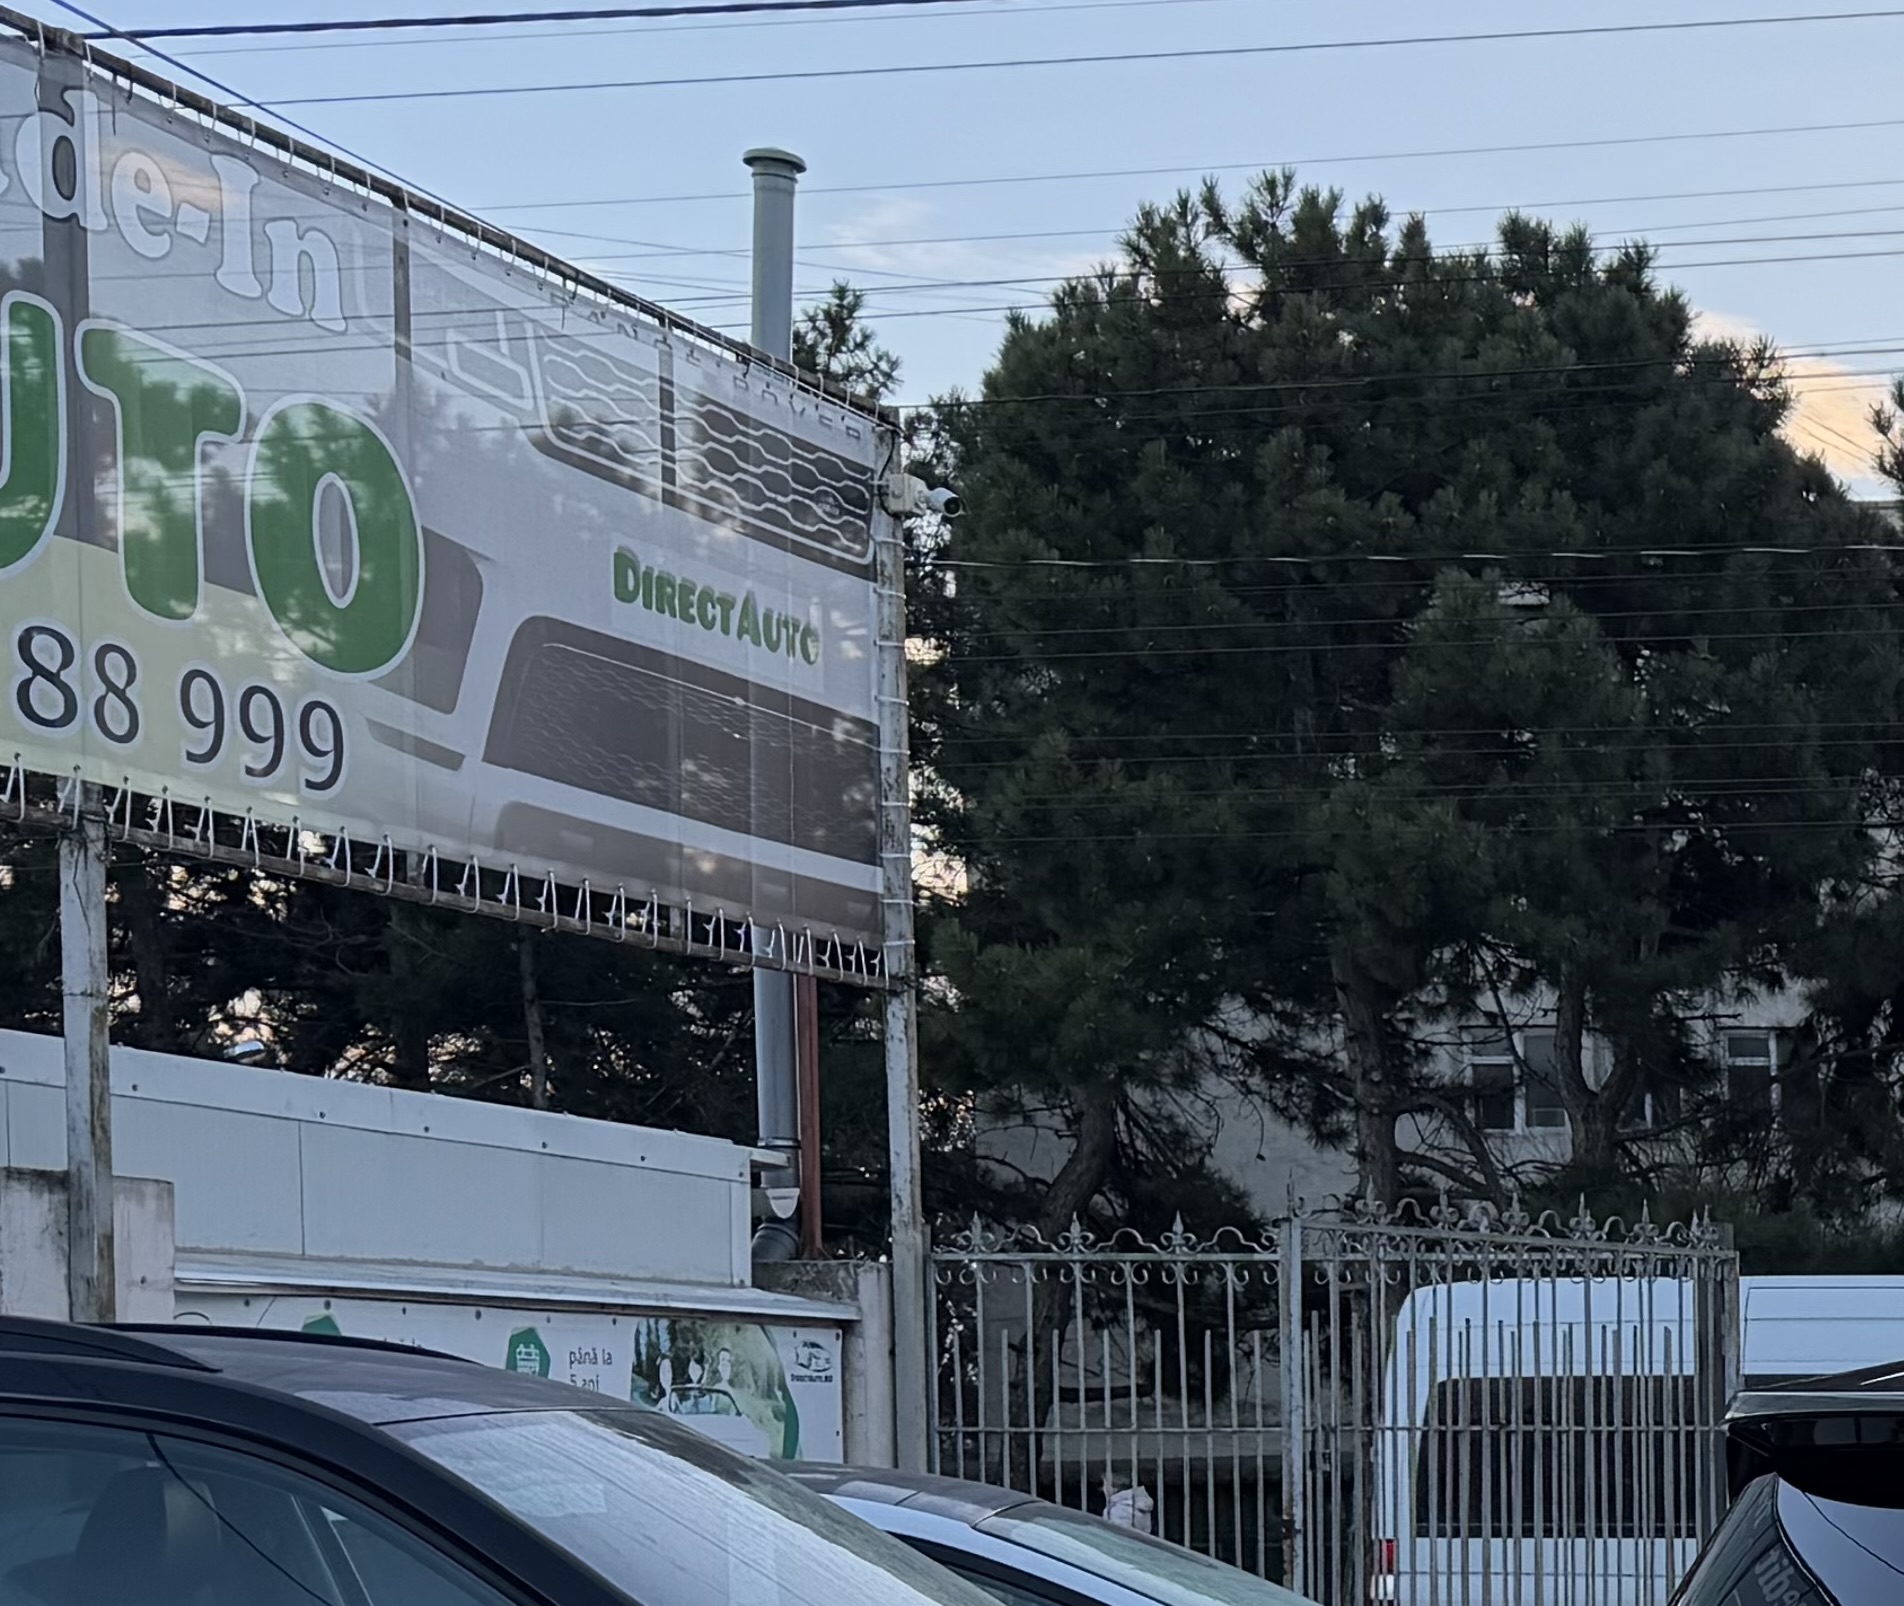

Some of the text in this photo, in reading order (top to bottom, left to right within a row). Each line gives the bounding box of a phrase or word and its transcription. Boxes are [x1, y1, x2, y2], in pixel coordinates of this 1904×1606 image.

[0, 87, 348, 334] de-In
[179, 668, 346, 792] 999
[602, 1348, 613, 1366] la
